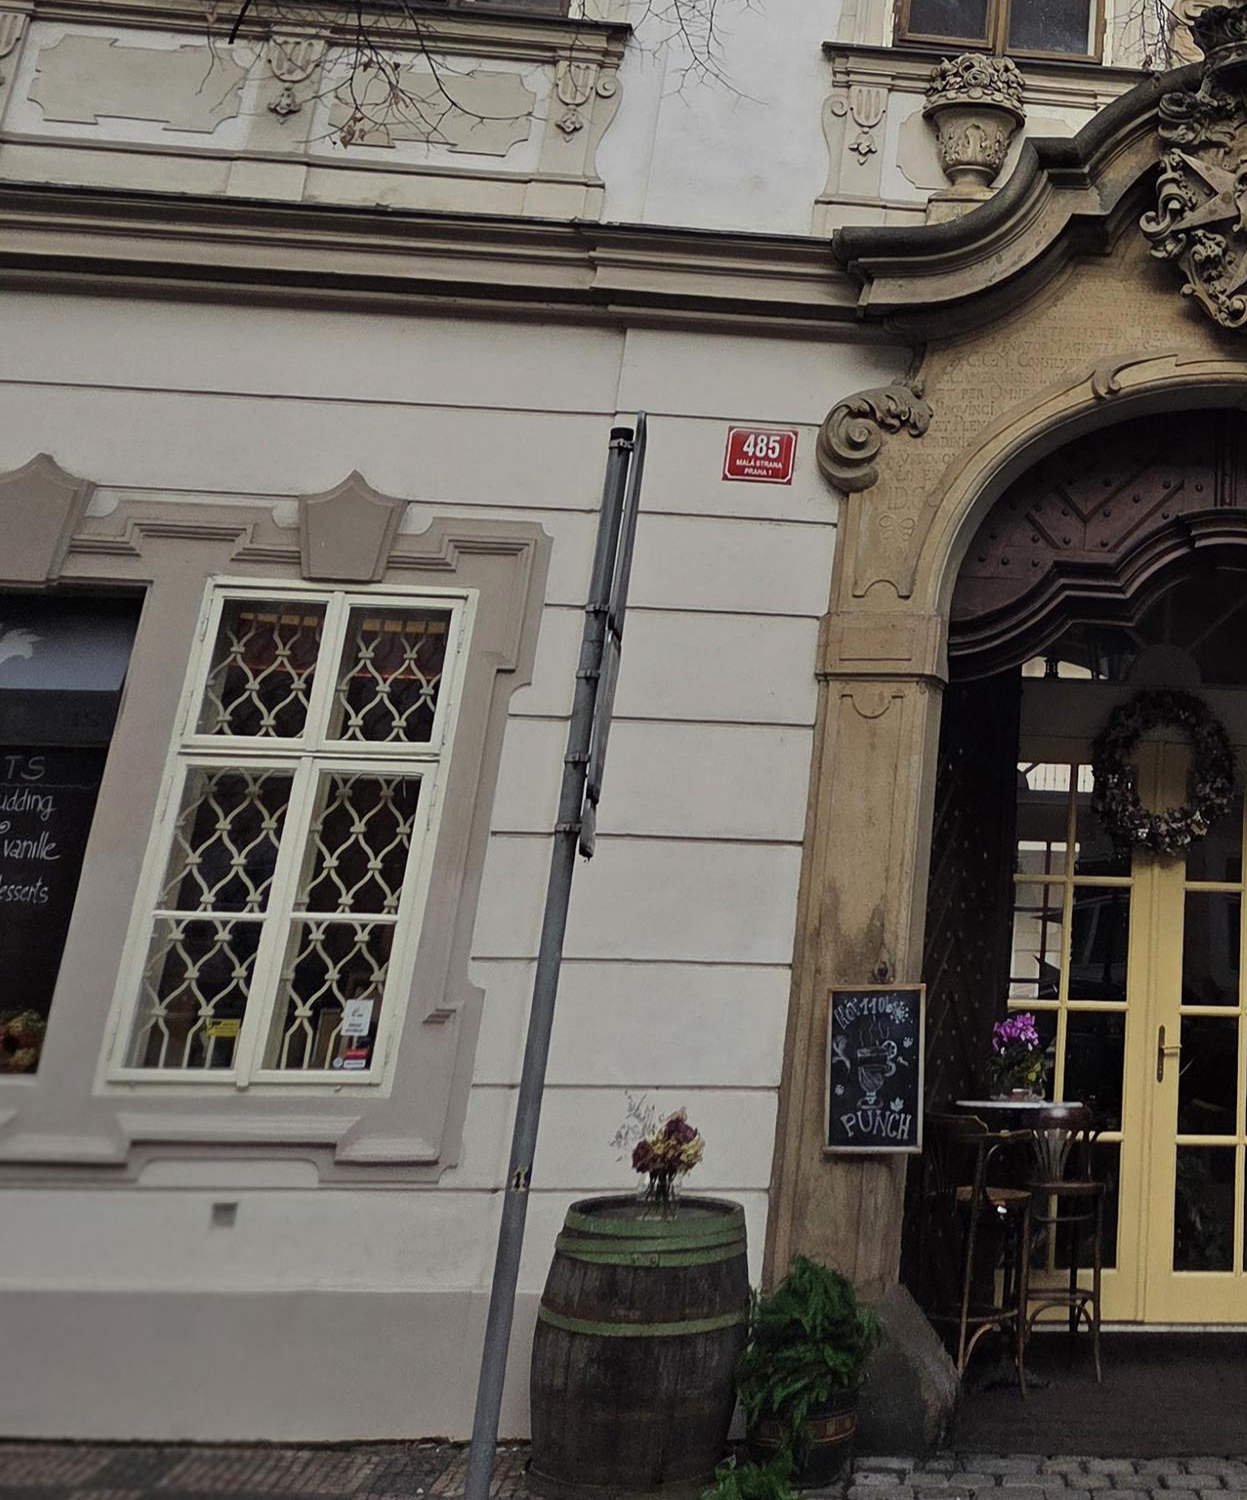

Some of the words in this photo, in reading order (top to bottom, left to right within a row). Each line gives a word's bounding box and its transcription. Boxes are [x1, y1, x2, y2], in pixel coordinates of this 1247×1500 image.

[743, 433, 781, 459] 485
[736, 459, 755, 467] MALÁ
[755, 460, 783, 469] STRANA
[744, 467, 767, 476] PRAHA
[768, 469, 773, 477] 1
[3, 831, 61, 861] vanille
[0, 875, 49, 904] esserts
[840, 1108, 912, 1140] PUNCH
